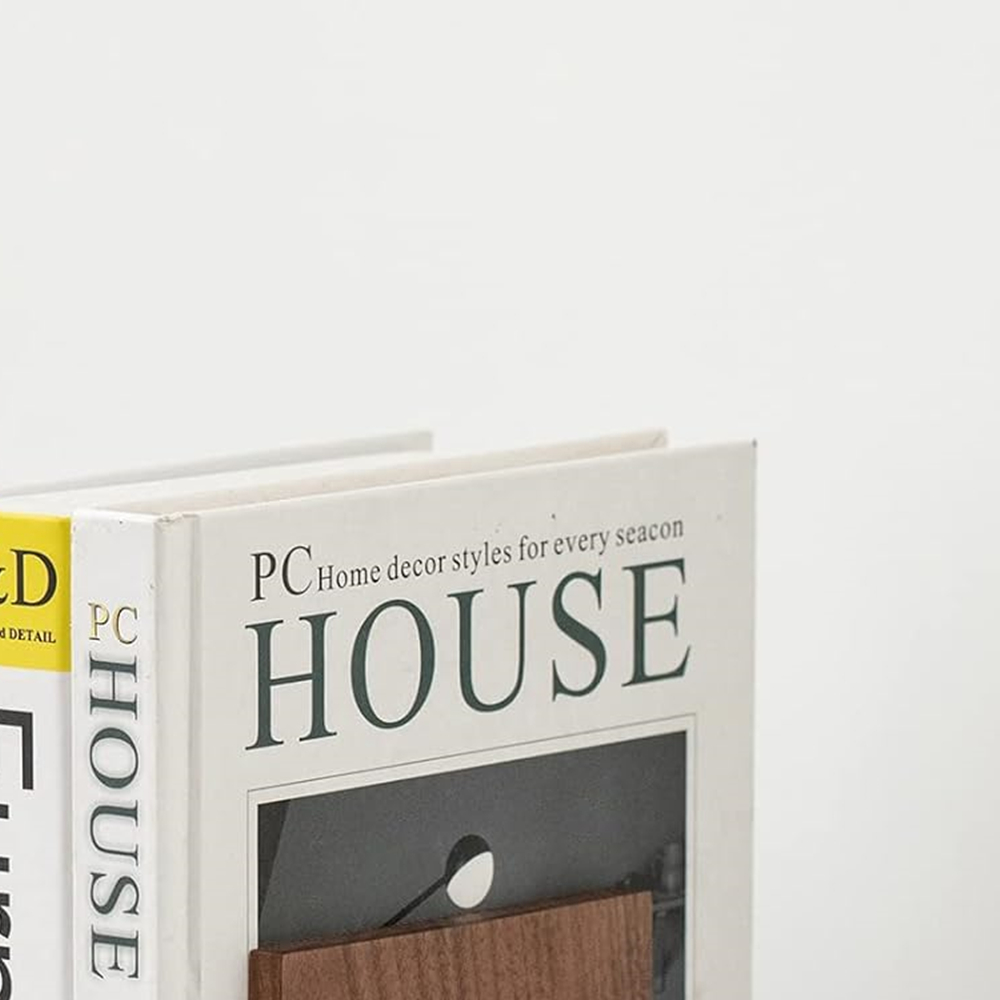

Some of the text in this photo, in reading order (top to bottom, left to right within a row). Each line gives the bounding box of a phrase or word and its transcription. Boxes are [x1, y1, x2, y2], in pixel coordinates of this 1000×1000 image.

[316, 563, 381, 592] Home
[386, 553, 447, 581] decor
[451, 540, 512, 576] styles
[518, 535, 549, 562] for
[553, 528, 611, 557] every
[615, 518, 685, 546] seacon
[9, 628, 57, 644] DETAIL
[245, 557, 692, 751] HOUSE
[89, 650, 140, 980] HOUSE
